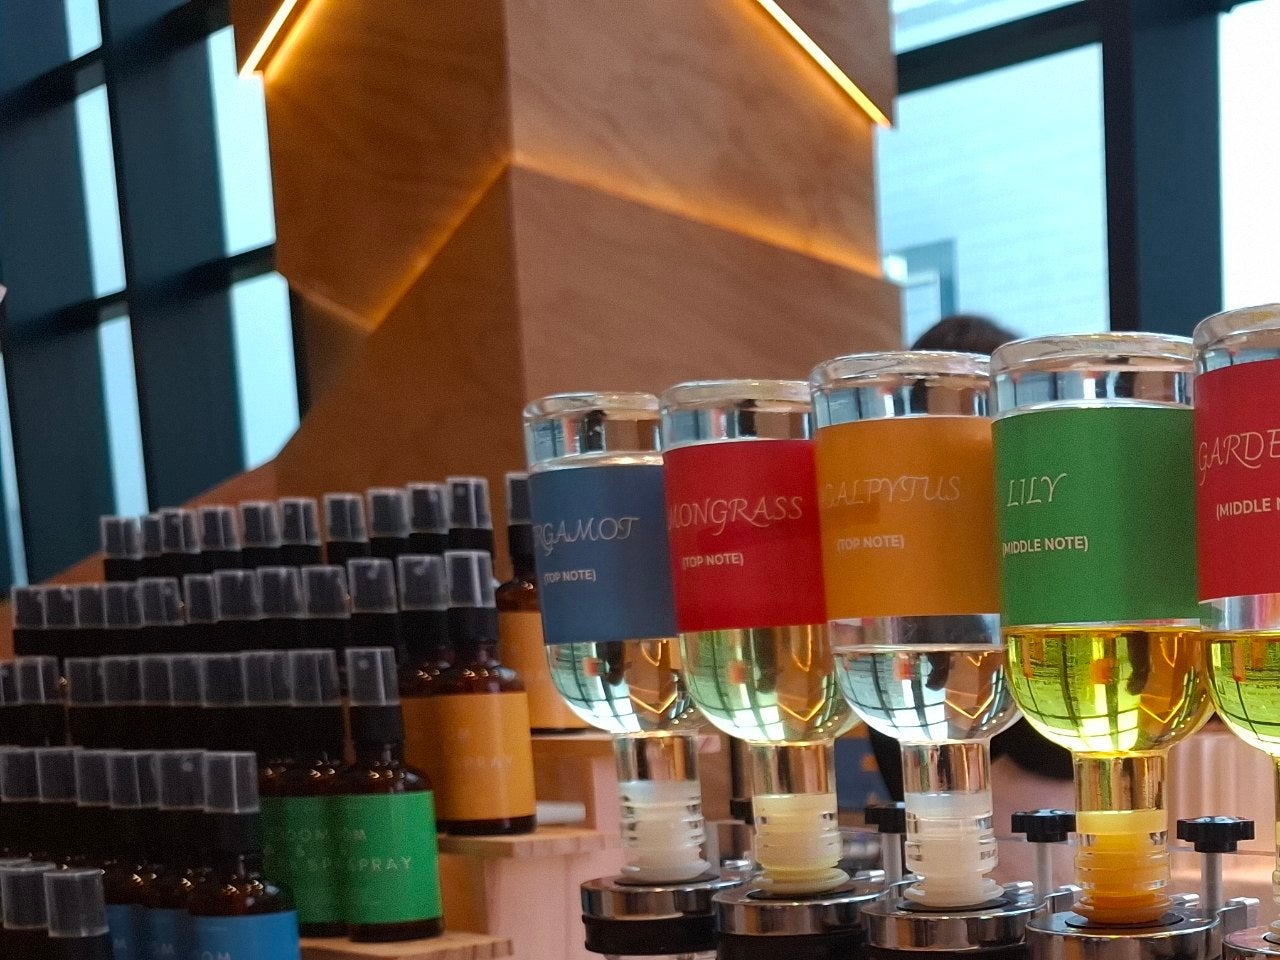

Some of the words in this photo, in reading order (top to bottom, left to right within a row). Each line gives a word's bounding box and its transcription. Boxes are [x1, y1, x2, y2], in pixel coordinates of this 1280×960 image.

[1007, 472, 1068, 507] LILY
[1216, 497, 1271, 521] (MIDDLE
[837, 538, 861, 553] (TOP
[863, 534, 905, 549] NOTE)
[1002, 538, 1042, 558] (MIDDLE
[1045, 535, 1089, 552] NOTE)
[682, 556, 704, 571] (TOP
[706, 552, 744, 567] NOTE)
[562, 568, 597, 583] NOTE)
